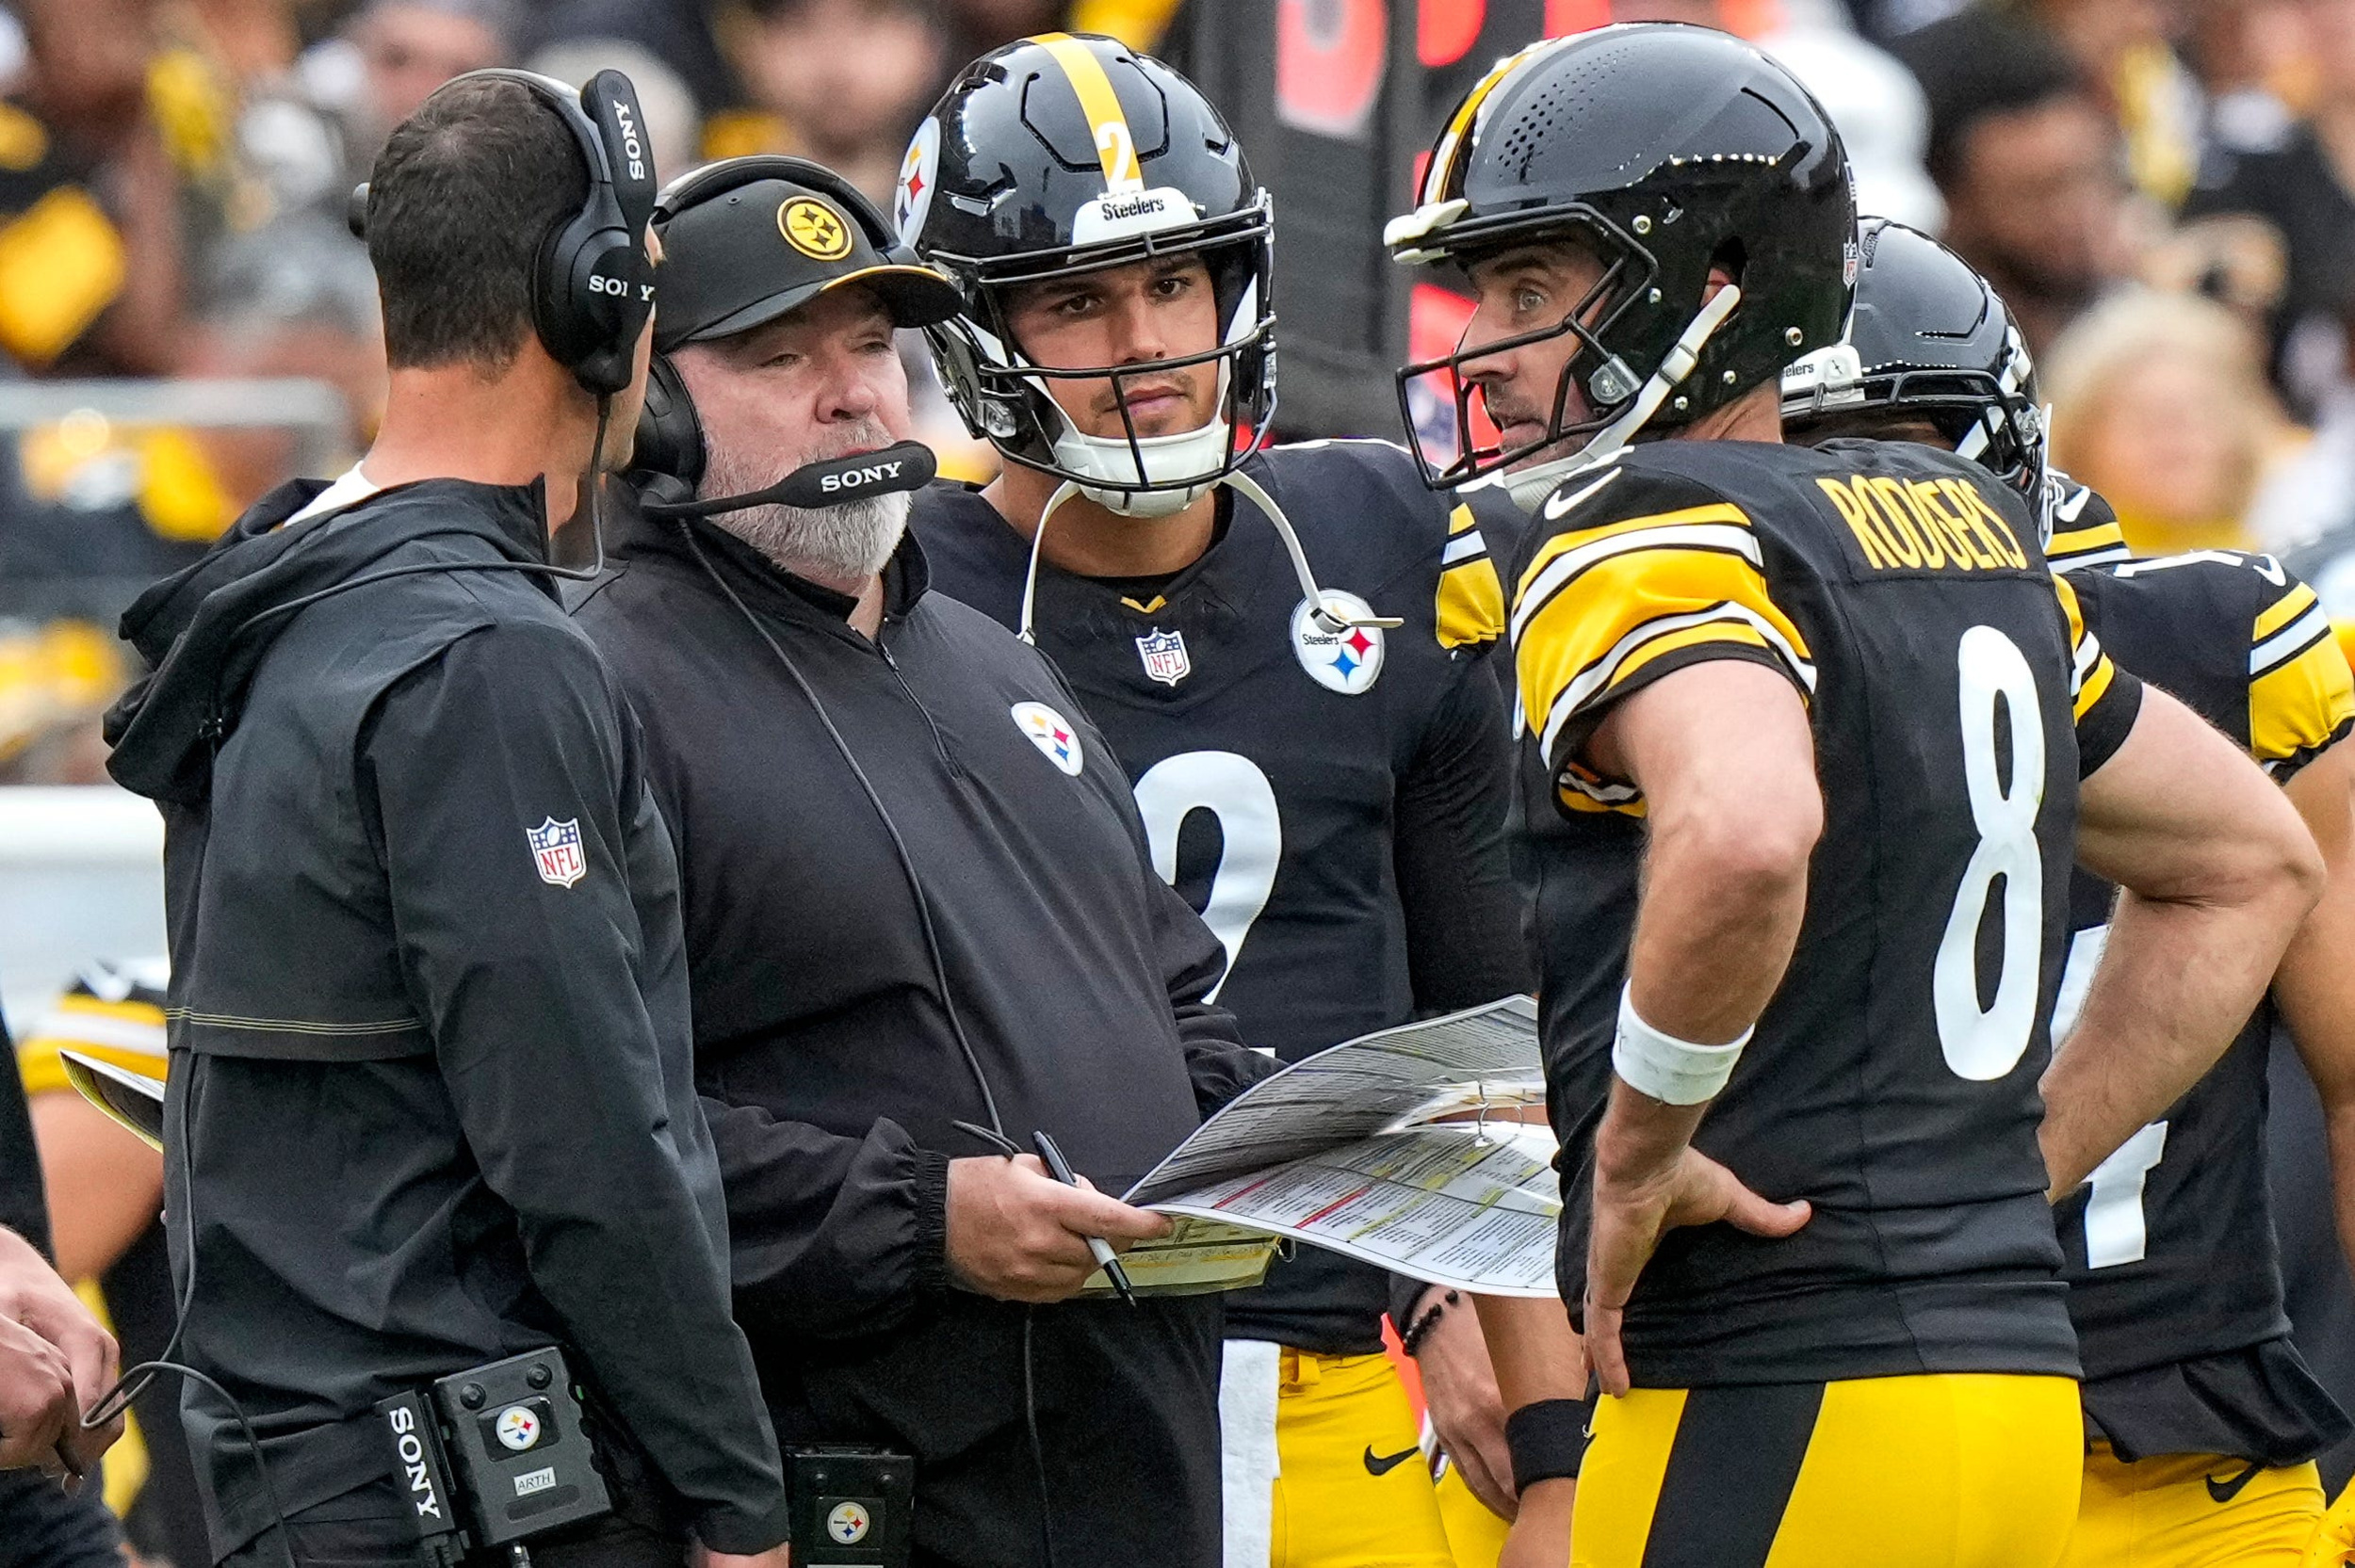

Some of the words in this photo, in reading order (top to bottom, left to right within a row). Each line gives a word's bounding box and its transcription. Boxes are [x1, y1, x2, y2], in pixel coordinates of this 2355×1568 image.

[612, 99, 645, 181] SONY
[1096, 120, 1145, 192] 2
[1101, 196, 1165, 221] Steelers
[1784, 363, 1814, 378] elers
[820, 461, 902, 493] SONY
[1814, 474, 2028, 571] RODGERS
[1302, 634, 1340, 646] Steelers
[1150, 653, 1183, 674] NFL
[540, 847, 579, 877] NFL
[1933, 624, 2046, 1081] 8
[1132, 750, 1283, 1006] 2
[389, 1406, 441, 1519] SONY
[518, 1473, 551, 1491] ARTH
